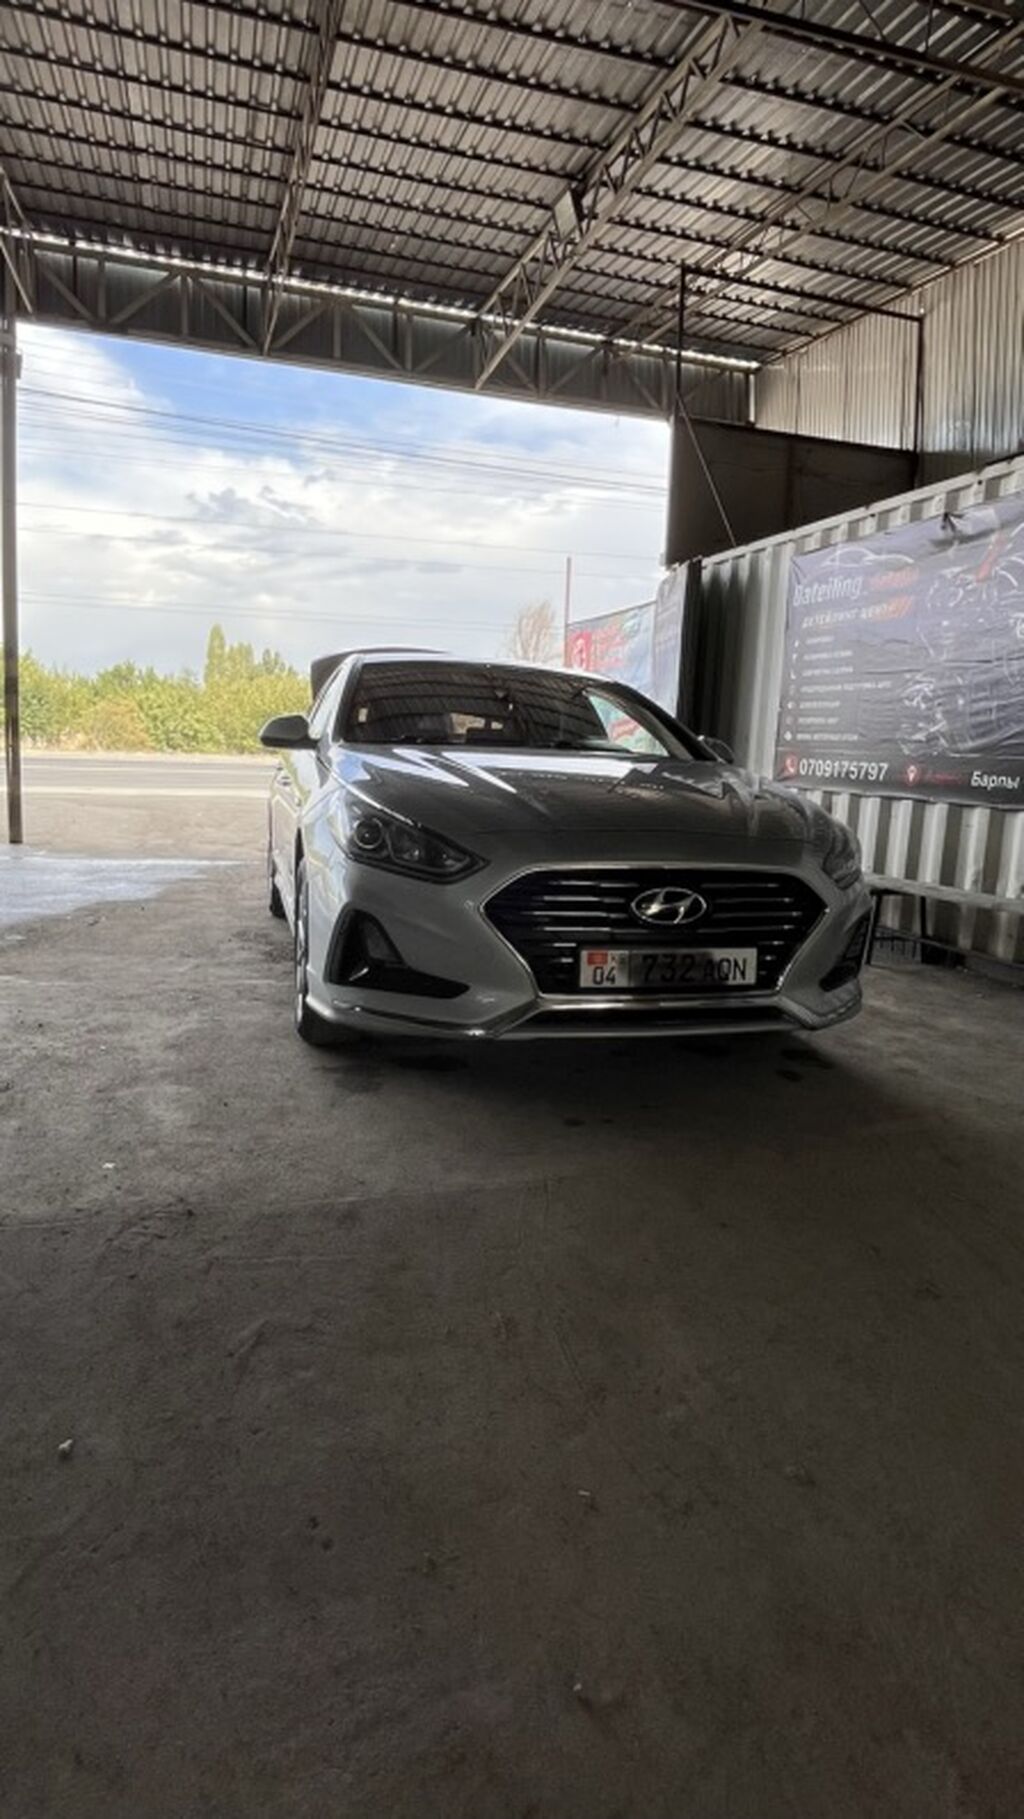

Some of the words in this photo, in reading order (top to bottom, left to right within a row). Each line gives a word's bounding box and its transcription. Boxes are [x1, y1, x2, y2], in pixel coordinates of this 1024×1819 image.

[799, 759, 888, 781] 0709175797
[593, 966, 616, 985] 04
[642, 953, 694, 983] 732
